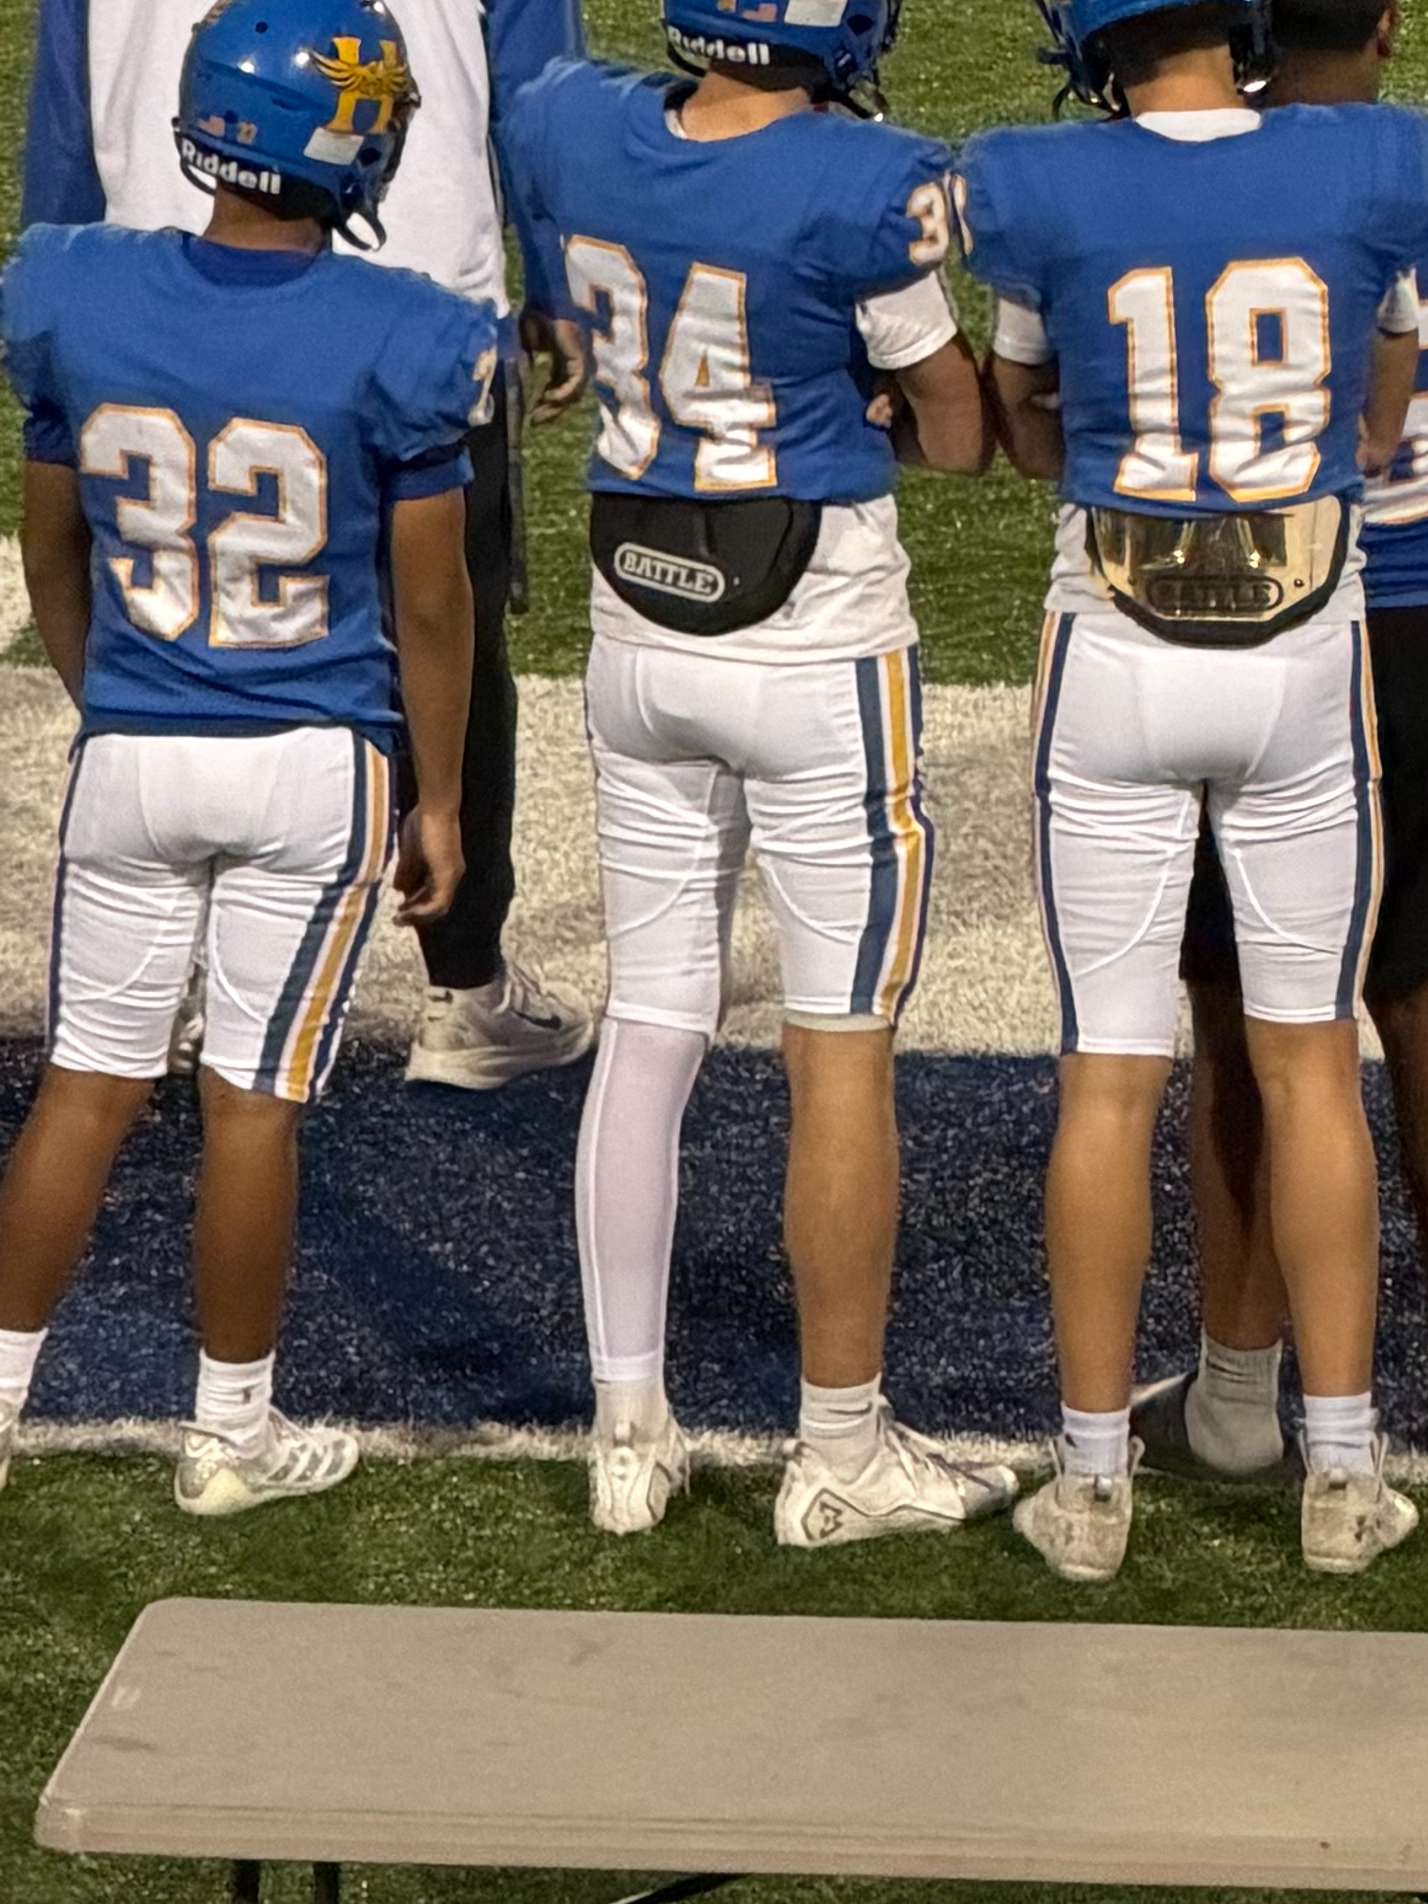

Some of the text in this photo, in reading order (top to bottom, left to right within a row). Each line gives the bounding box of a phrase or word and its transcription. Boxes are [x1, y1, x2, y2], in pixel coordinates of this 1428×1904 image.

[666, 24, 771, 66] Riddell
[180, 137, 282, 196] Riddell
[906, 182, 950, 266] 3
[565, 233, 778, 490] 34
[1107, 255, 1333, 504] 18
[79, 402, 328, 646] 32
[622, 547, 714, 596] BATTLE
